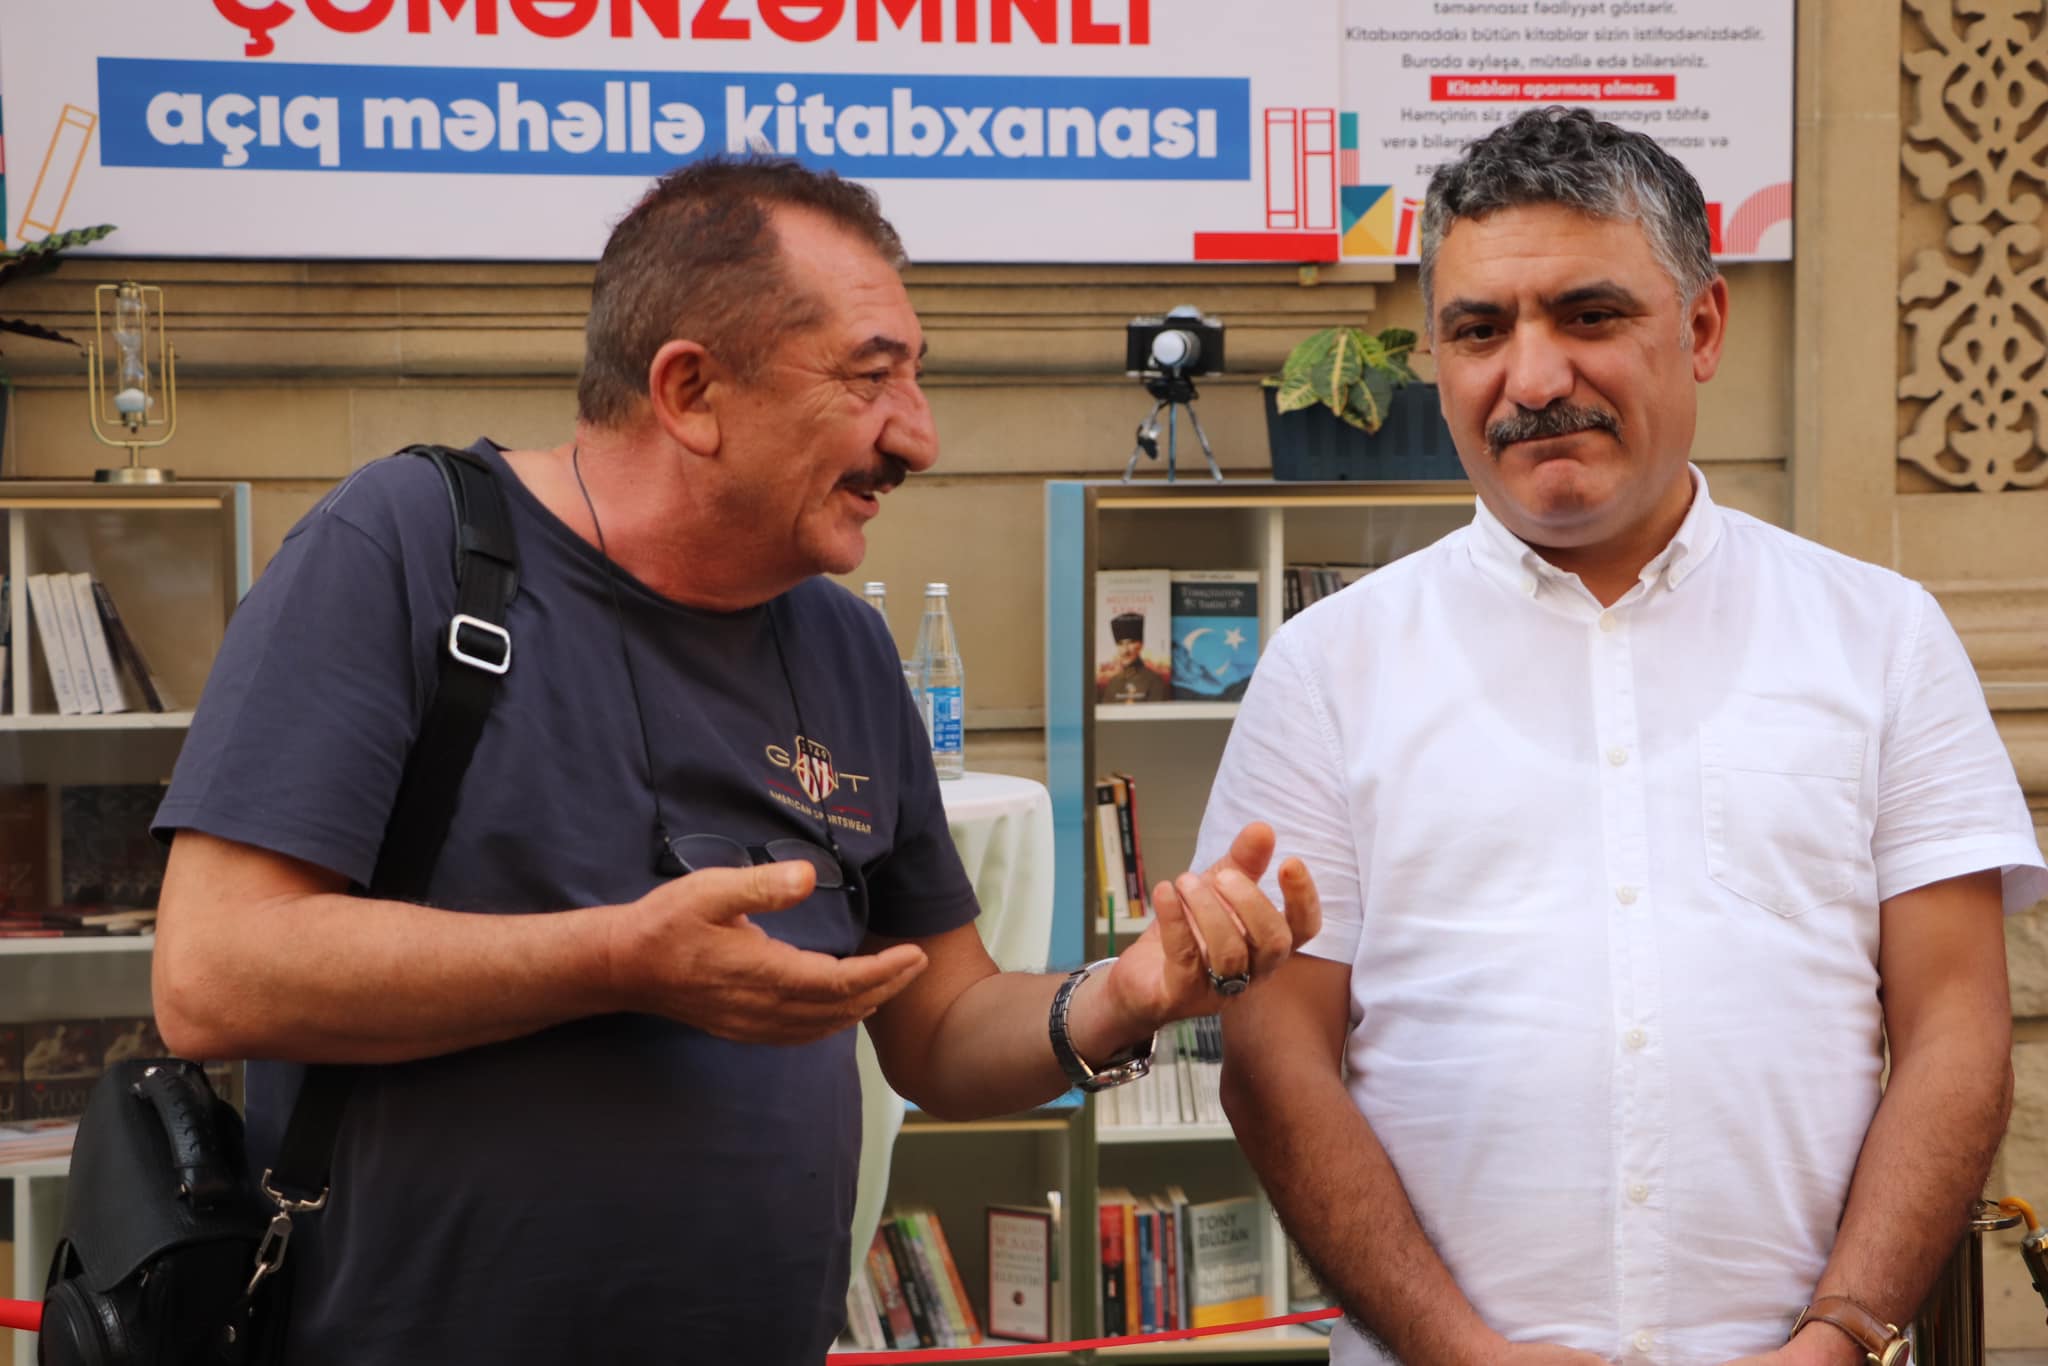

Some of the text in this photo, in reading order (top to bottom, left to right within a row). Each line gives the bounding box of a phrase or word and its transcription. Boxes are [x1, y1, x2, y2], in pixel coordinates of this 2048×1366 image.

[1609, 0, 1677, 18] göstərir.
[1344, 26, 1764, 42] Kitabxanadakı bütün kitablar sizin istifadənizdədir.
[1401, 53, 1709, 72] Burada əyləşə, mütaliə edə bilərsiniz.
[1447, 79, 1660, 99] Kitabları aparmaq olmaz.
[1400, 107, 1477, 125] Həmçinin
[1482, 107, 1503, 122] siz
[1666, 107, 1711, 122] töhfə
[147, 81, 1217, 167] açıq məhəllə kitabxanası
[1381, 136, 1418, 149] verə
[1709, 136, 1730, 149] və
[1198, 1214, 1238, 1231] TONY
[1198, 1229, 1250, 1250] BUZAN
